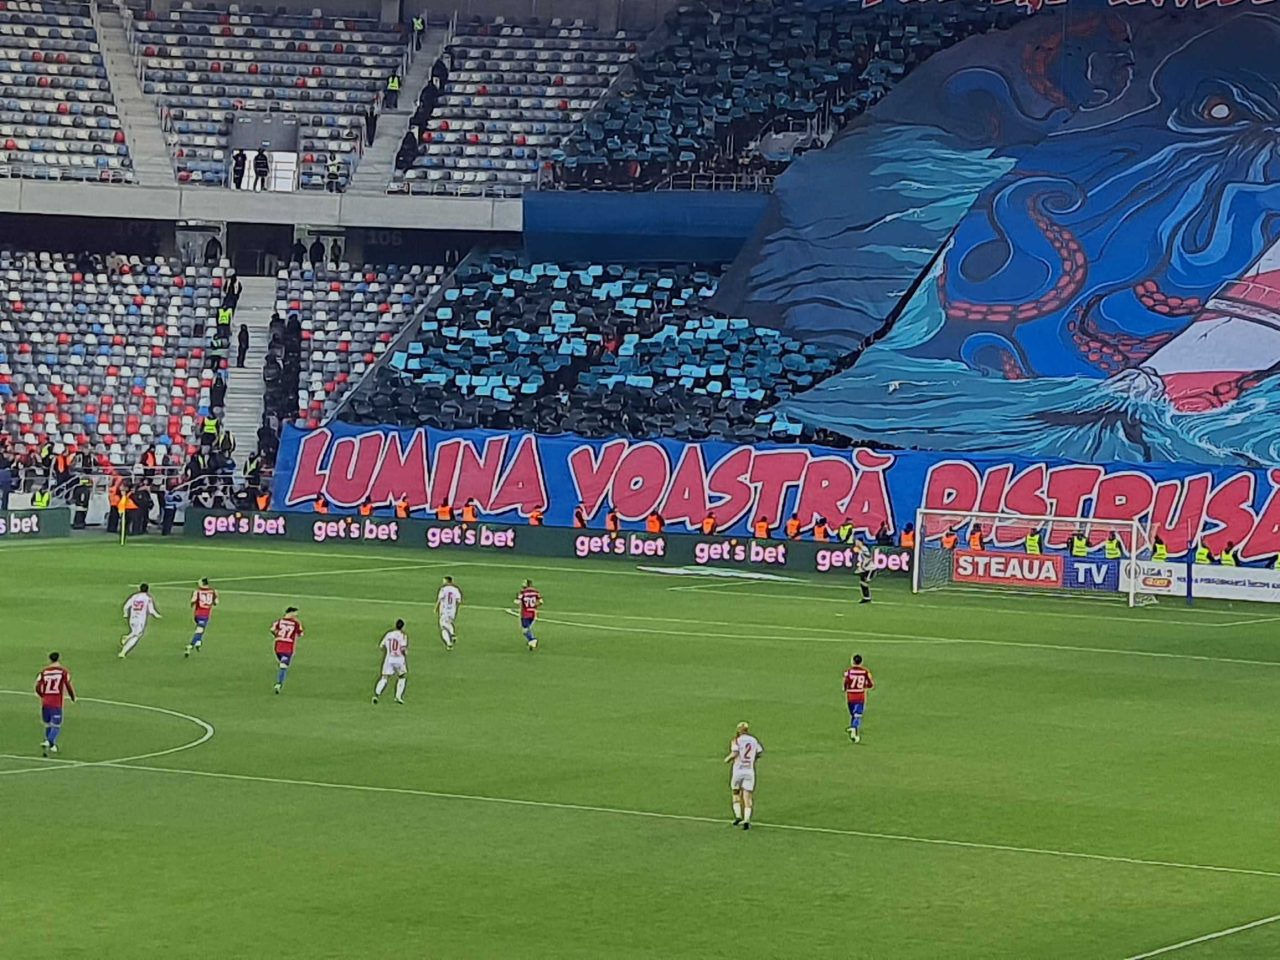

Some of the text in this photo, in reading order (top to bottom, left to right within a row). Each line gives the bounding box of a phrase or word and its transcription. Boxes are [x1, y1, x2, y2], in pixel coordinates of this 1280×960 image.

[285, 427, 547, 517] LUMINA
[569, 440, 895, 537] VOASTRĂ
[11, 515, 38, 533] bet
[204, 512, 285, 534] get's bet
[314, 517, 397, 540] get's bet
[427, 523, 514, 547] get's bet
[576, 533, 664, 556] get's bet
[695, 539, 785, 563] get's bet
[874, 549, 909, 572] bet
[957, 555, 1057, 581] STEAUA
[1074, 562, 1110, 584] TV
[743, 742, 752, 759] 2
